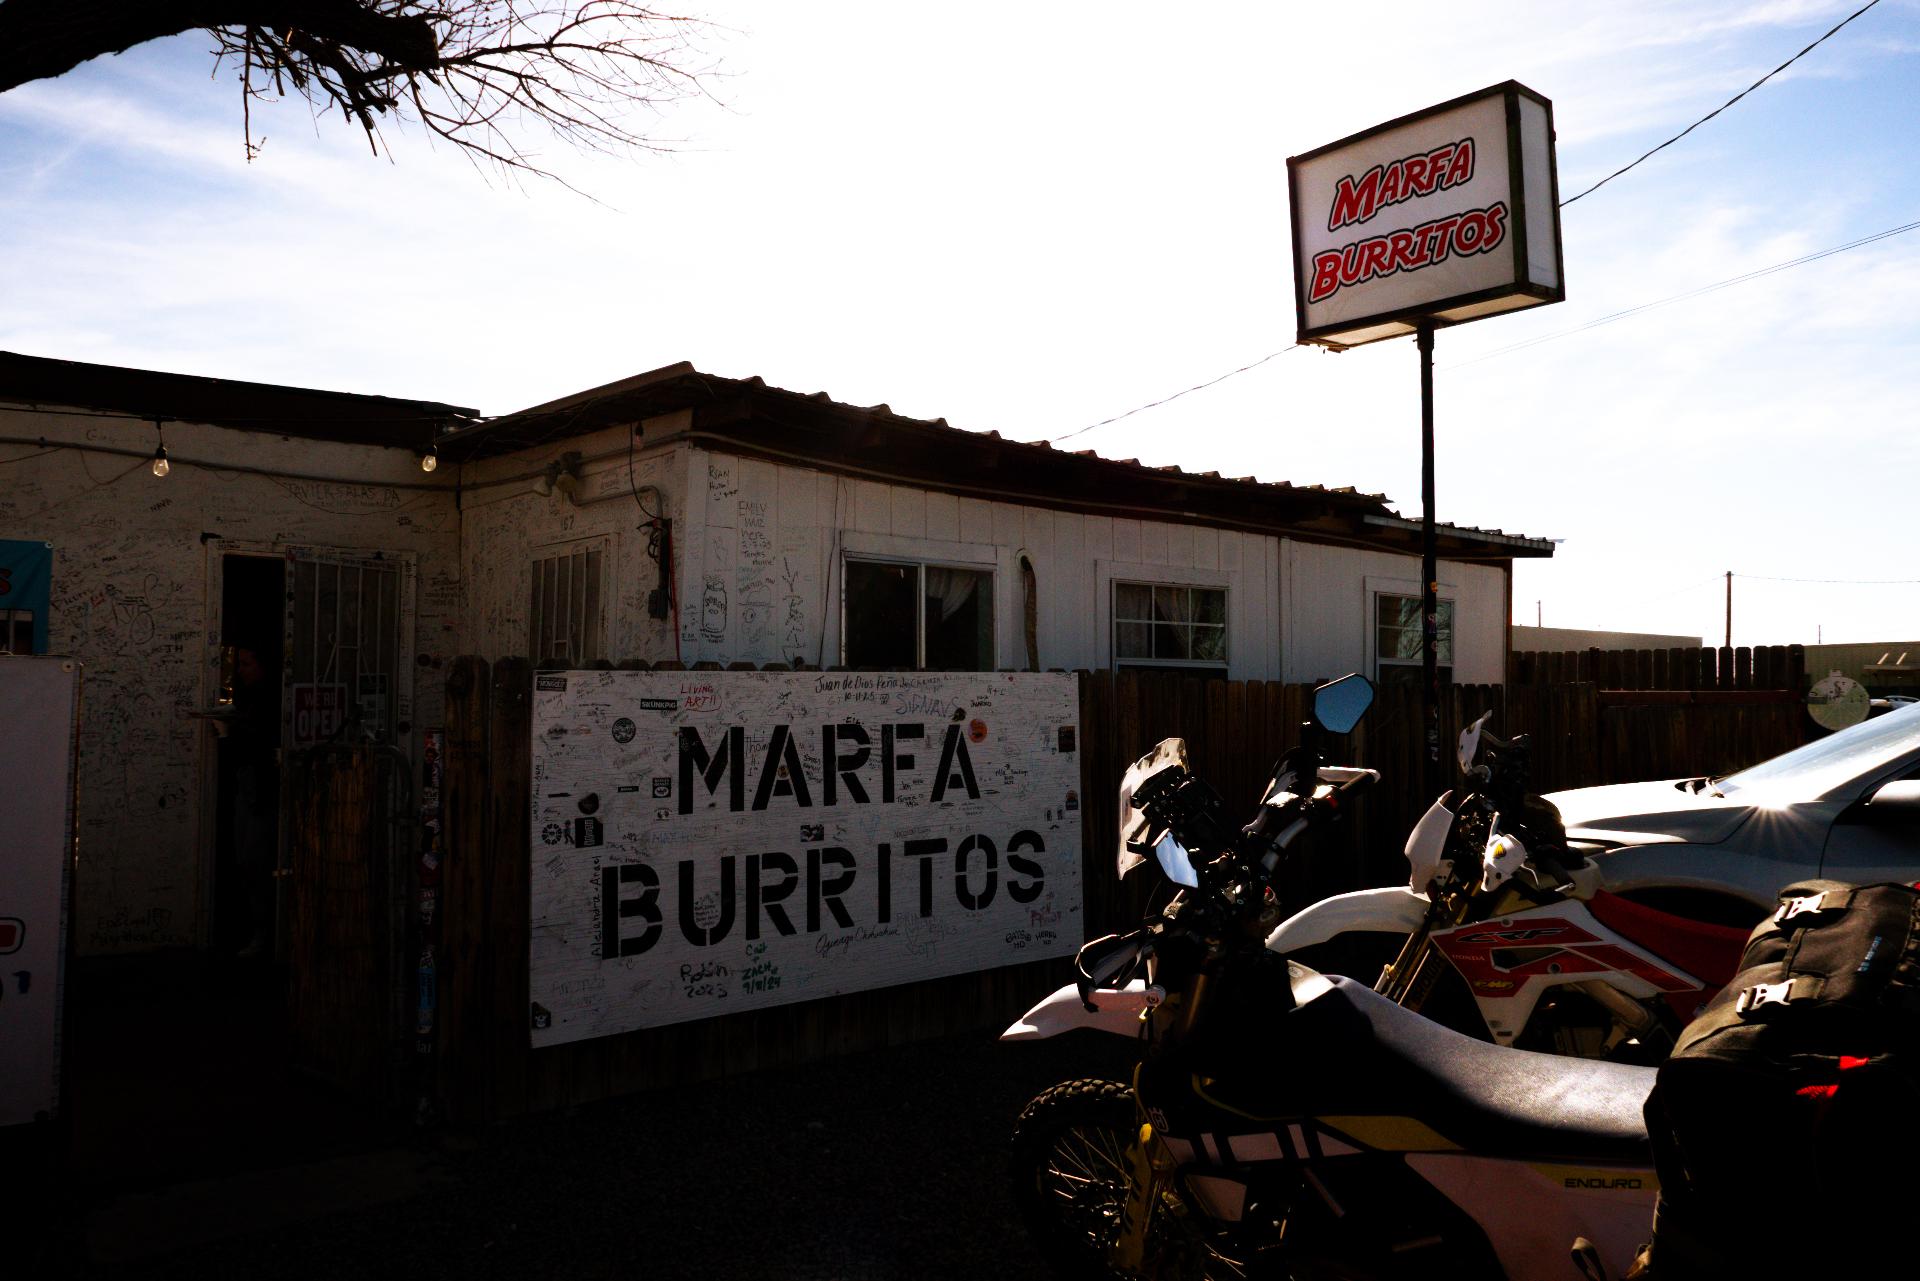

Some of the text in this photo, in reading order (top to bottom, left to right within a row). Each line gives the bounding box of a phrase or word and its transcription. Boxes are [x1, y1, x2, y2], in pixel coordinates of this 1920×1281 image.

[1329, 137, 1475, 231] MARFA
[1309, 202, 1508, 303] BURRITOS
[681, 683, 714, 694] LIVING
[815, 676, 840, 693] Juan
[842, 677, 853, 689] de
[854, 678, 874, 689] Dios
[679, 724, 981, 815] MARFA
[602, 830, 1045, 960] BURRITOS
[1564, 1178, 1642, 1190] ENDURO
